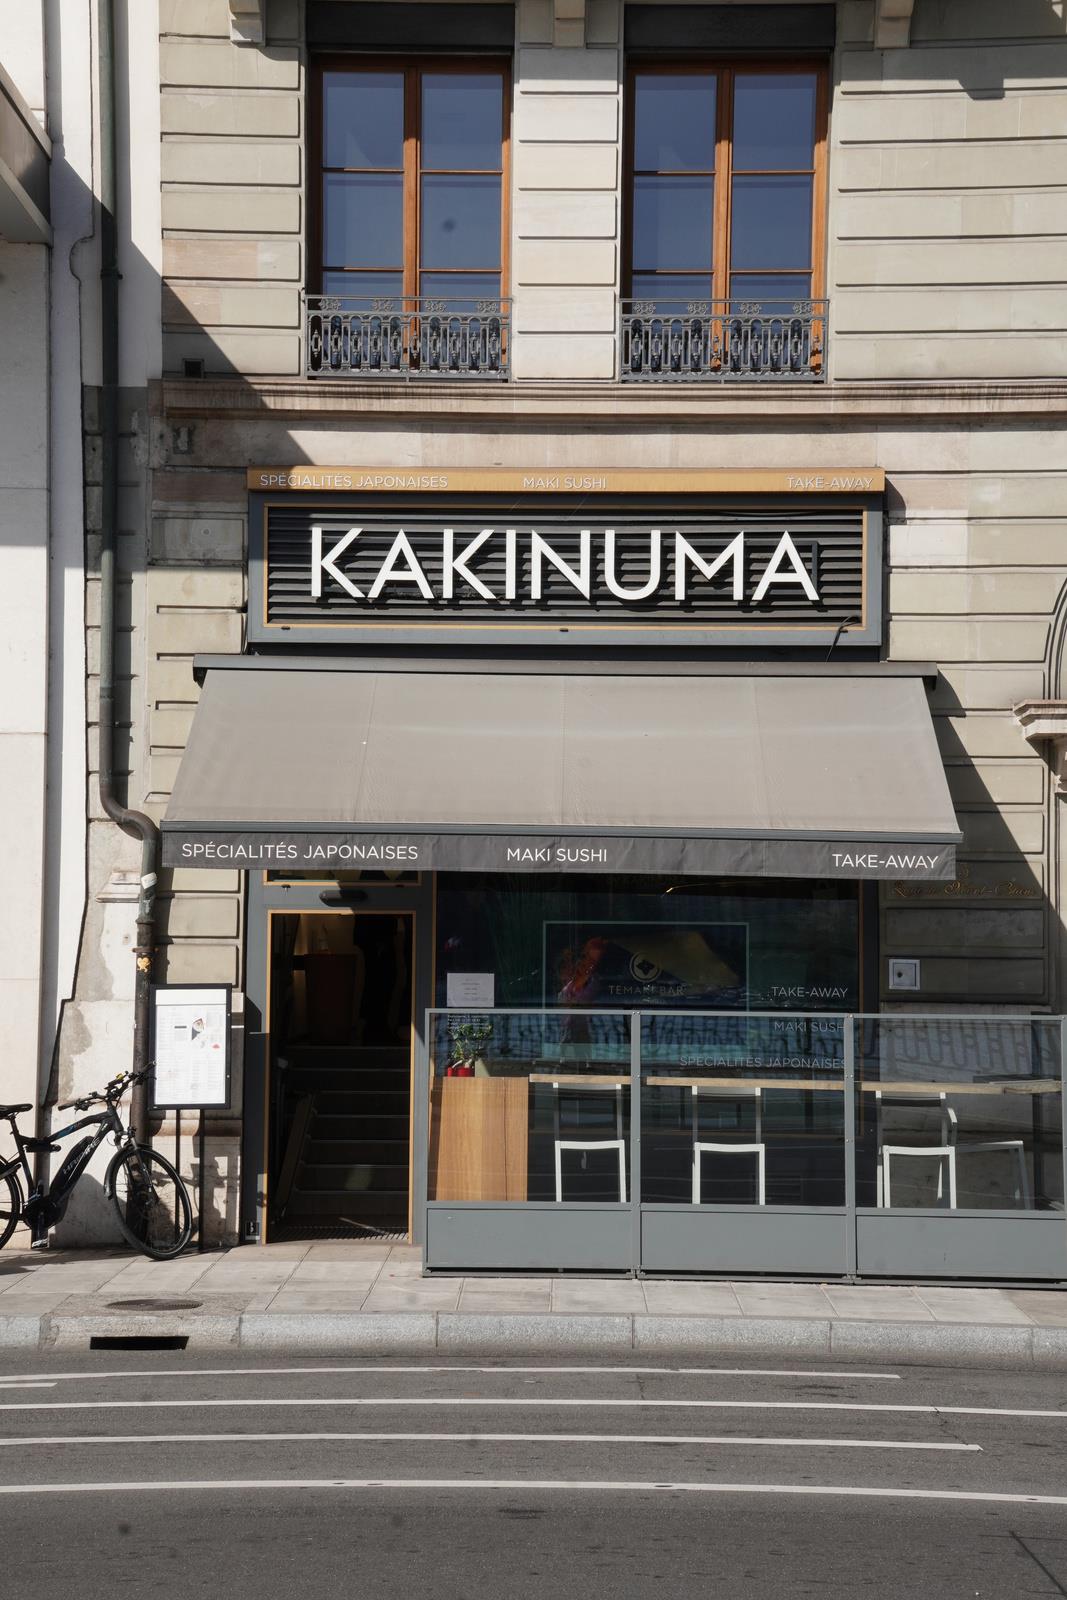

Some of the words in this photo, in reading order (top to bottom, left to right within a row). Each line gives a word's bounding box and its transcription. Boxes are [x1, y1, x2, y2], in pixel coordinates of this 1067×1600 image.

[259, 473, 352, 488] SPÉCIALITÉS
[356, 475, 448, 488] JAPONAISES
[523, 477, 560, 489] MAKI
[564, 477, 607, 489] SUSHI
[787, 477, 873, 489] TAKE-AWAY
[311, 527, 820, 601] KAKINUMA
[182, 841, 297, 859] SPÉCIALITÉS
[303, 845, 418, 860] JAPONAISES
[506, 848, 551, 862] MAKI
[556, 848, 607, 863] SUSHI
[832, 853, 938, 869] TAKE-AWAY
[771, 986, 848, 998] TAKE-AWAY
[774, 1021, 807, 1032] MAKI
[811, 1022, 845, 1033] SUSH
